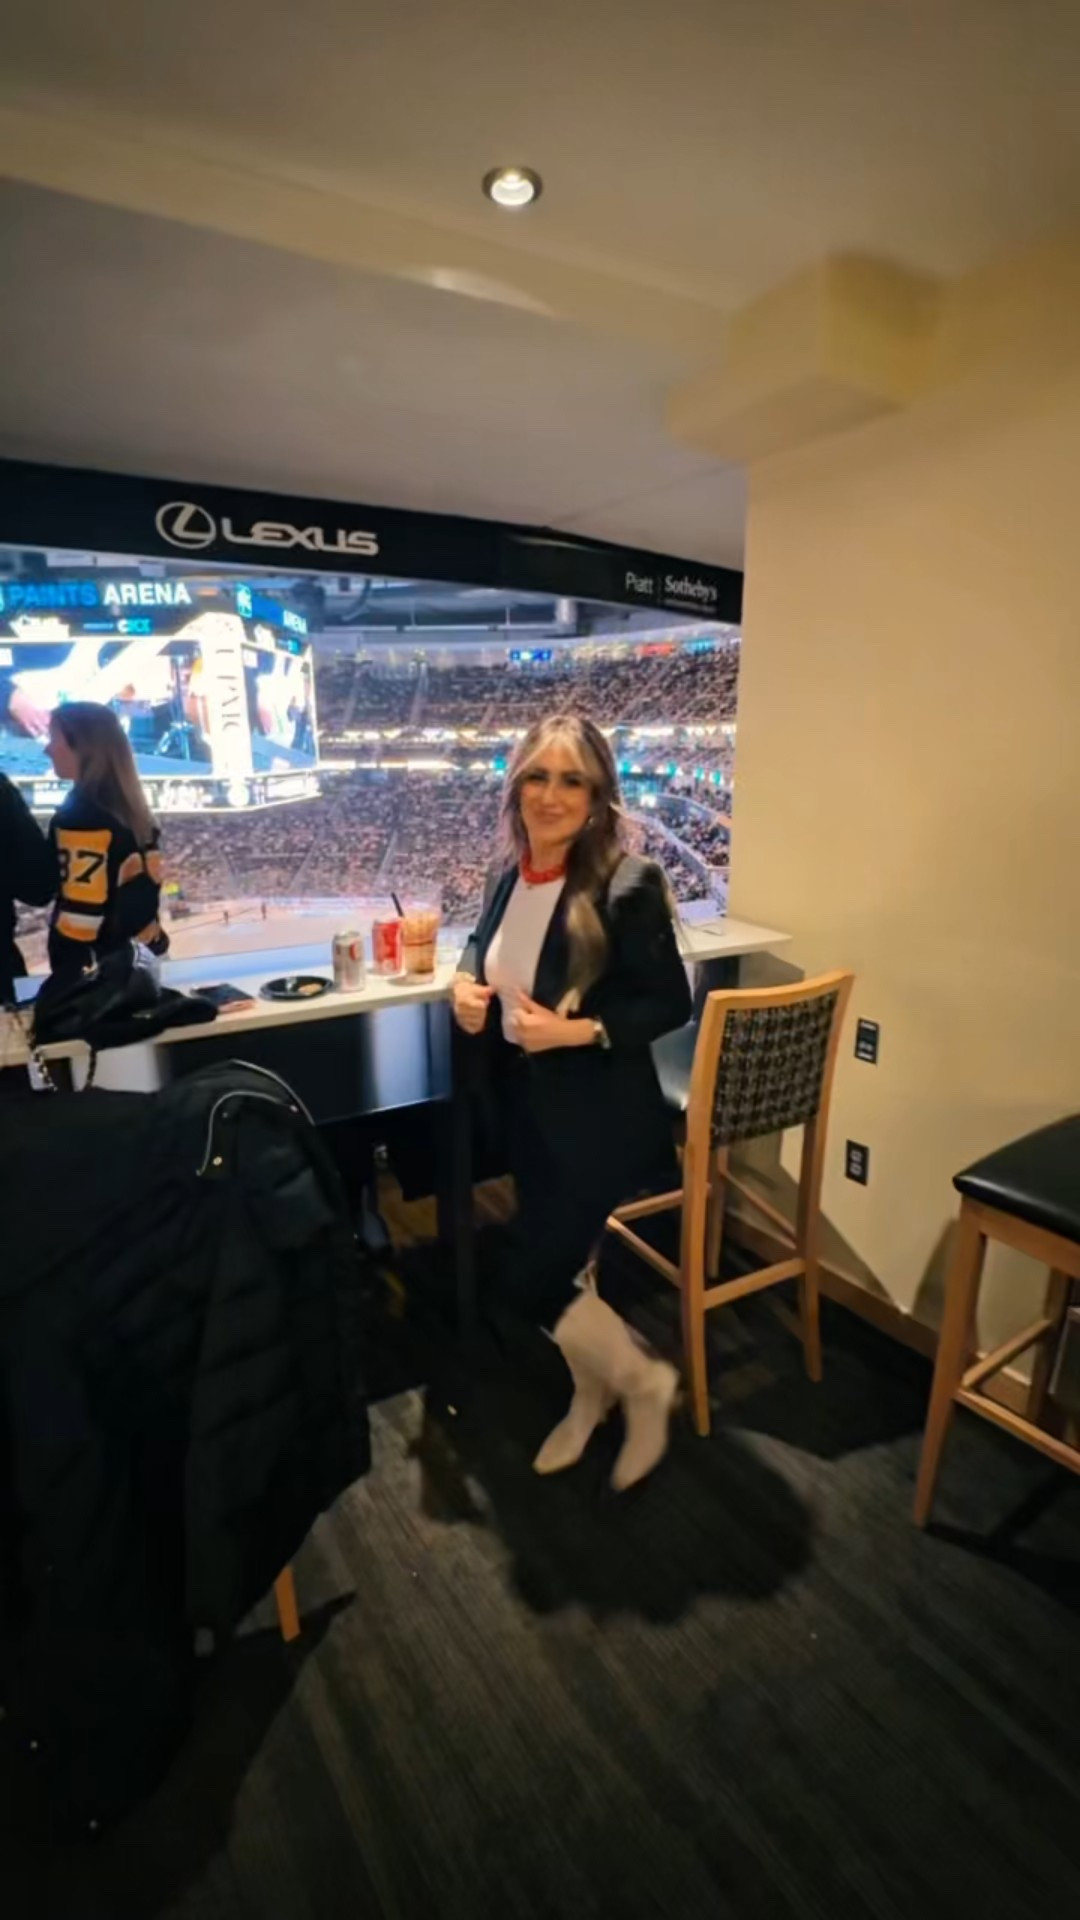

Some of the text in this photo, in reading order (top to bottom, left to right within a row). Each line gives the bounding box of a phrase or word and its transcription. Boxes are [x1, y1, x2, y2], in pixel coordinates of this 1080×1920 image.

[221, 517, 379, 556] LEXUS
[9, 584, 97, 606] PAINTS
[103, 583, 192, 605] ARENA
[664, 575, 718, 603] Sotheby's
